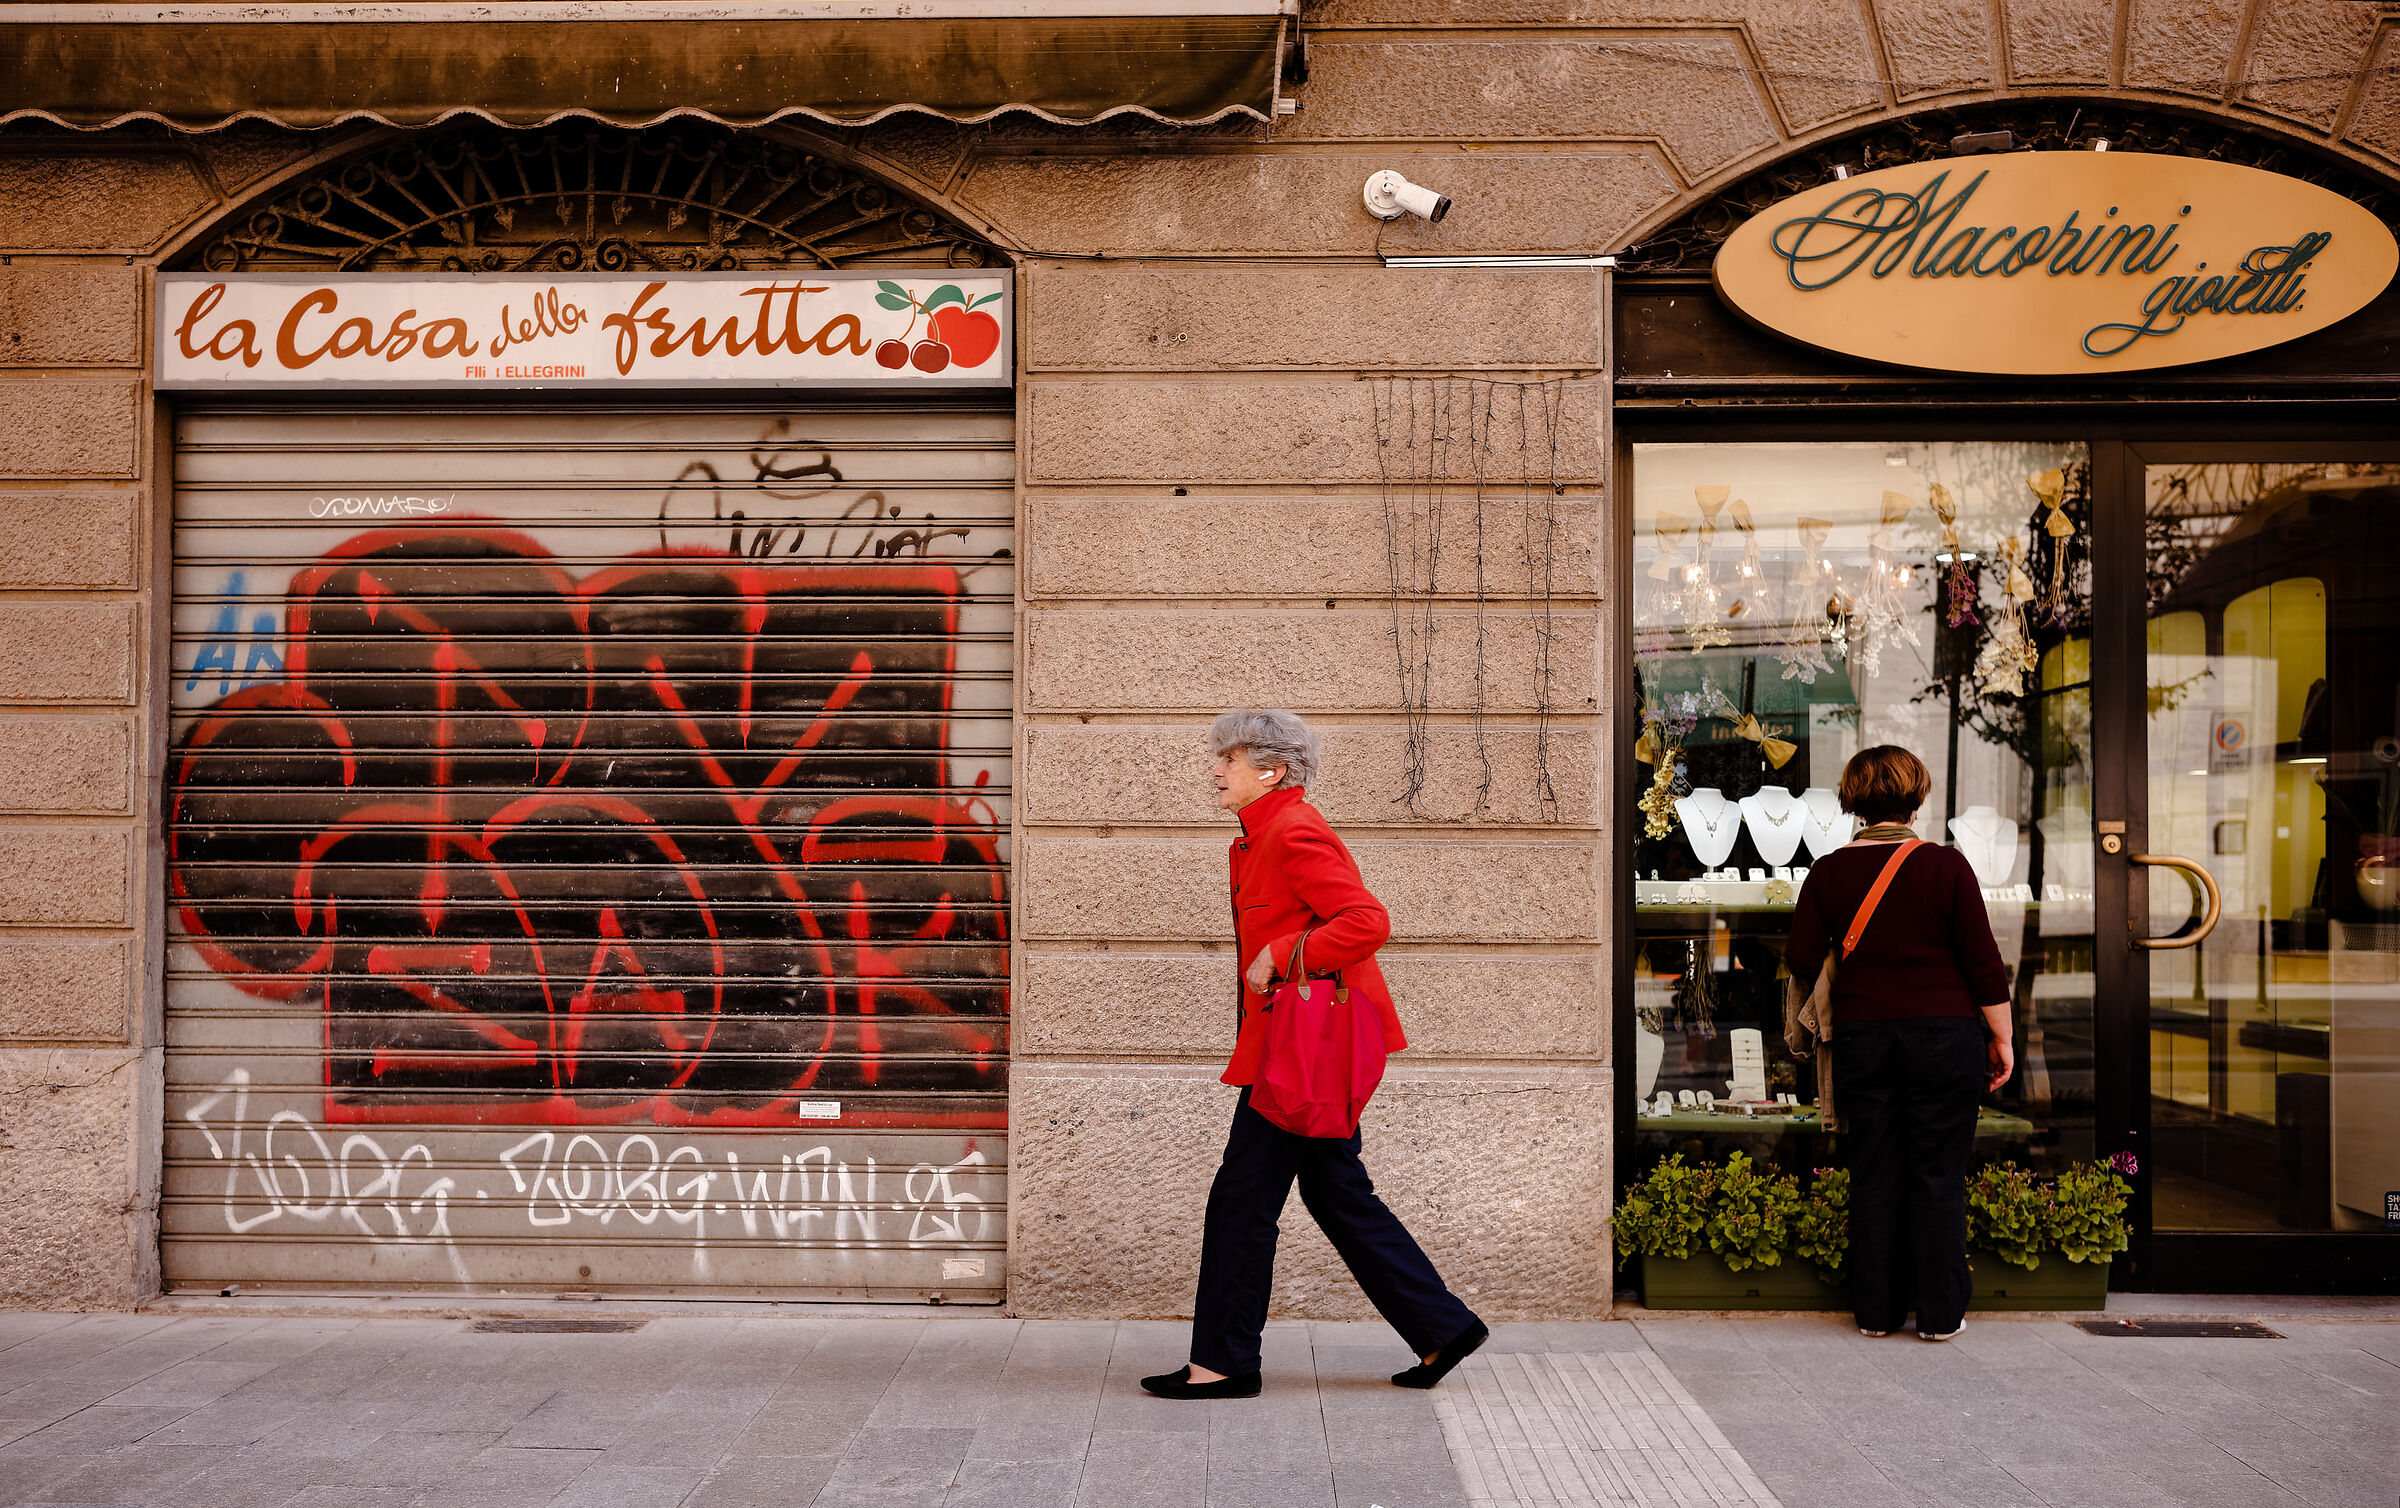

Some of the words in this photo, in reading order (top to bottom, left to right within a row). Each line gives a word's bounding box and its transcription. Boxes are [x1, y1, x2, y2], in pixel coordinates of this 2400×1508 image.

[1772, 169, 2192, 291] Macorini
[174, 283, 263, 368] la
[276, 288, 479, 370] Casa
[489, 286, 589, 358] della
[602, 280, 872, 377] frutta
[496, 366, 585, 378] ELLEGRINI
